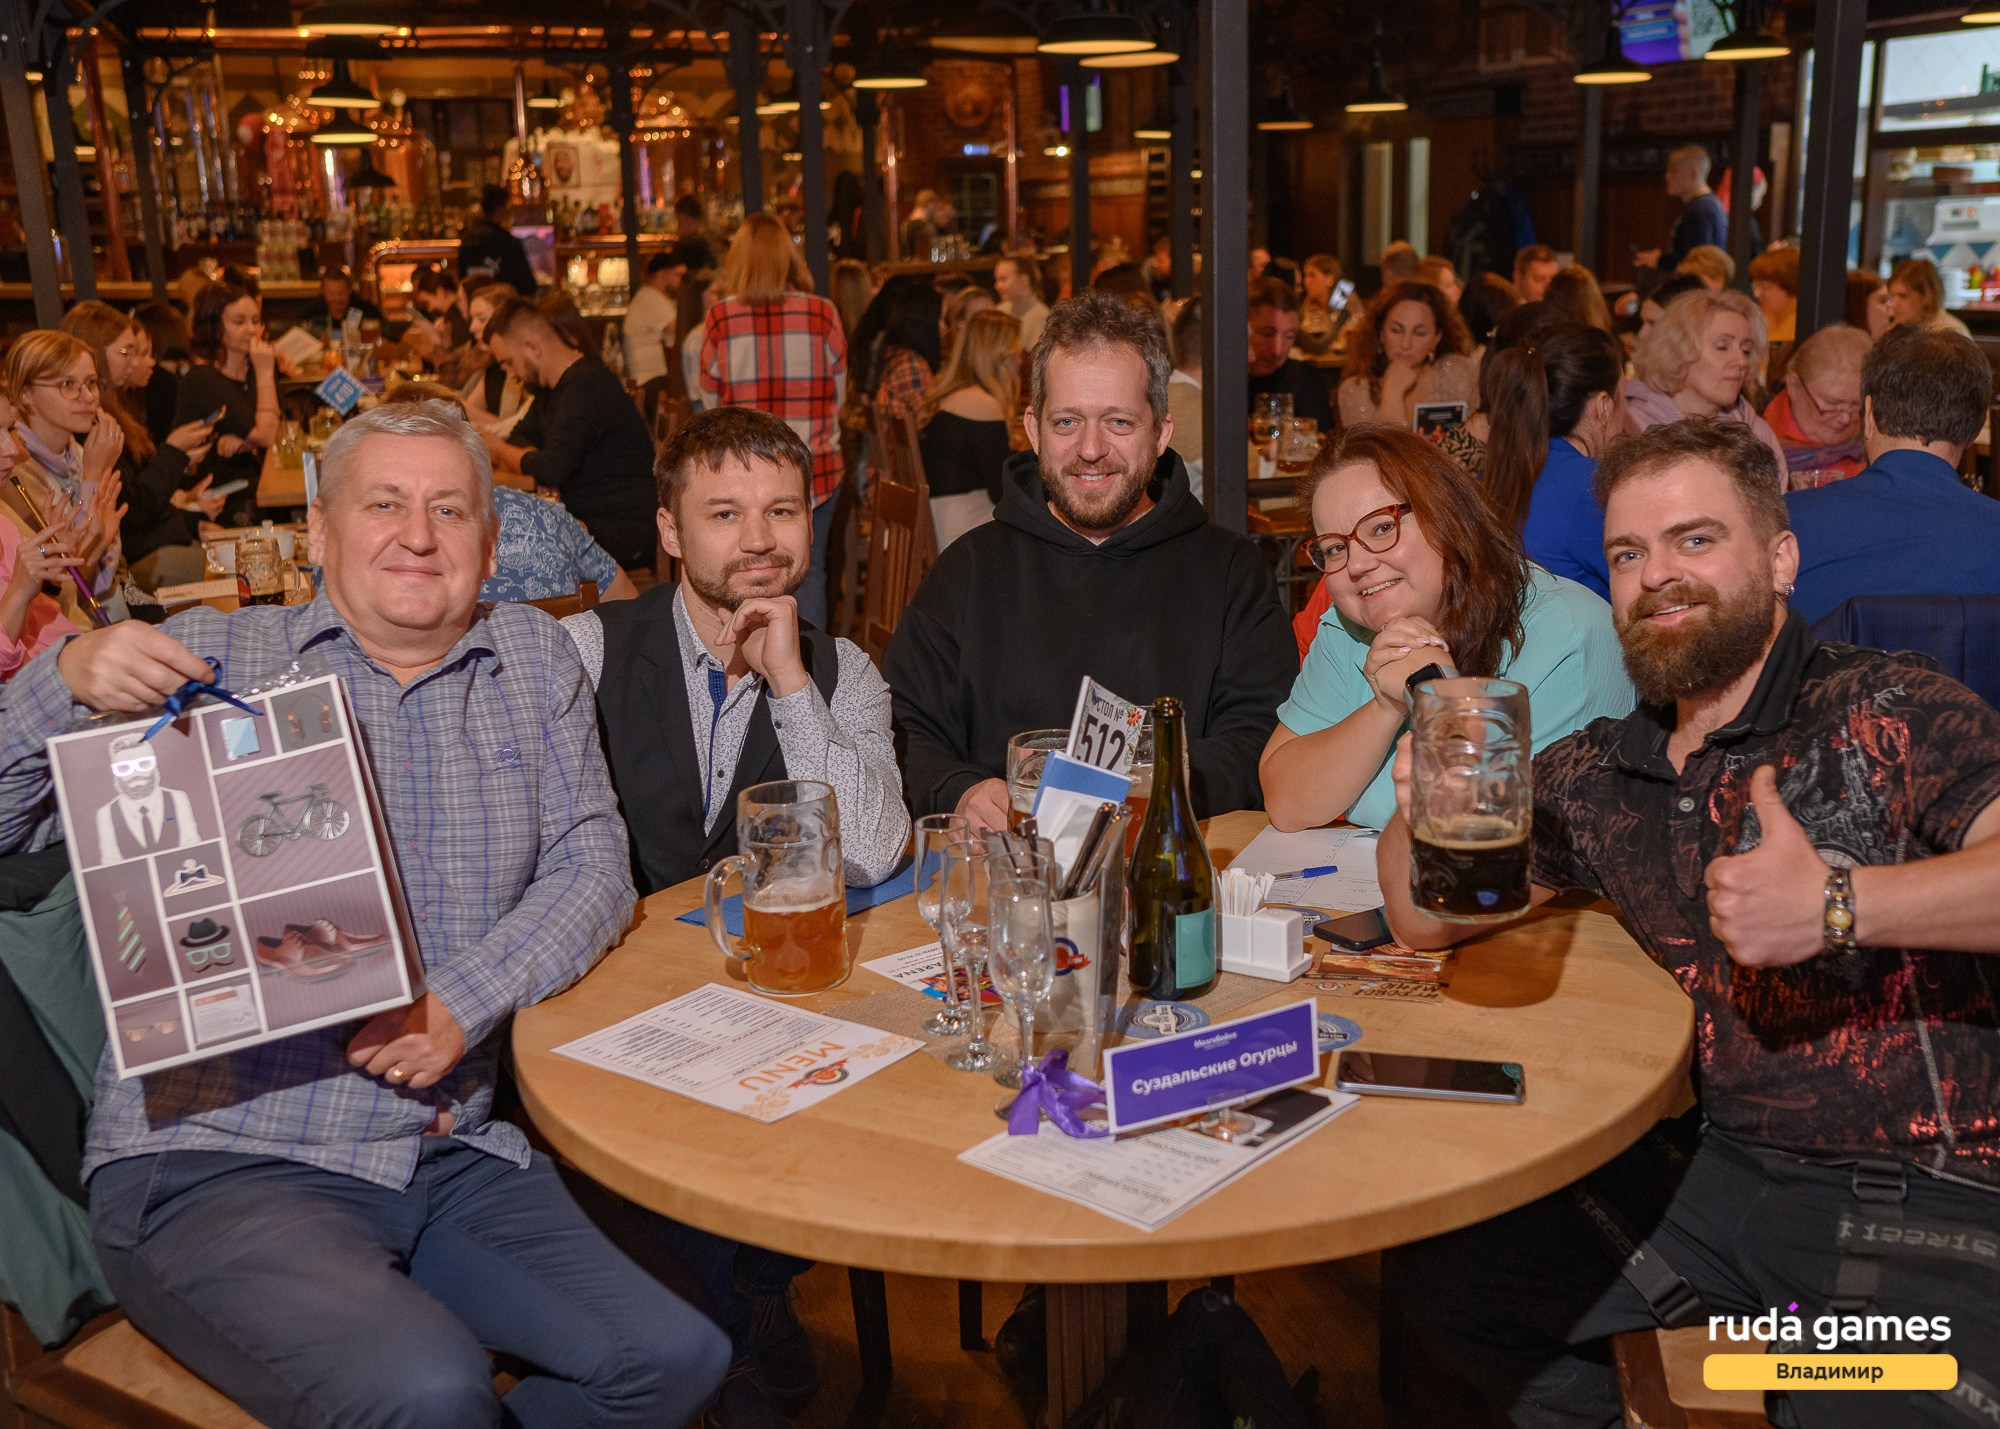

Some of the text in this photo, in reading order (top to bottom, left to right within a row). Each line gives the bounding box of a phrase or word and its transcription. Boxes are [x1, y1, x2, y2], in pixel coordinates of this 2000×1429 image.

[1096, 696, 1114, 719] СТОЛ
[1076, 713, 1126, 771] 512
[891, 961, 942, 979] ARENA
[738, 1040, 846, 1091] MENU
[1131, 1040, 1298, 1096] Суздальские Огурцы
[1861, 1223, 1998, 1258] STREET
